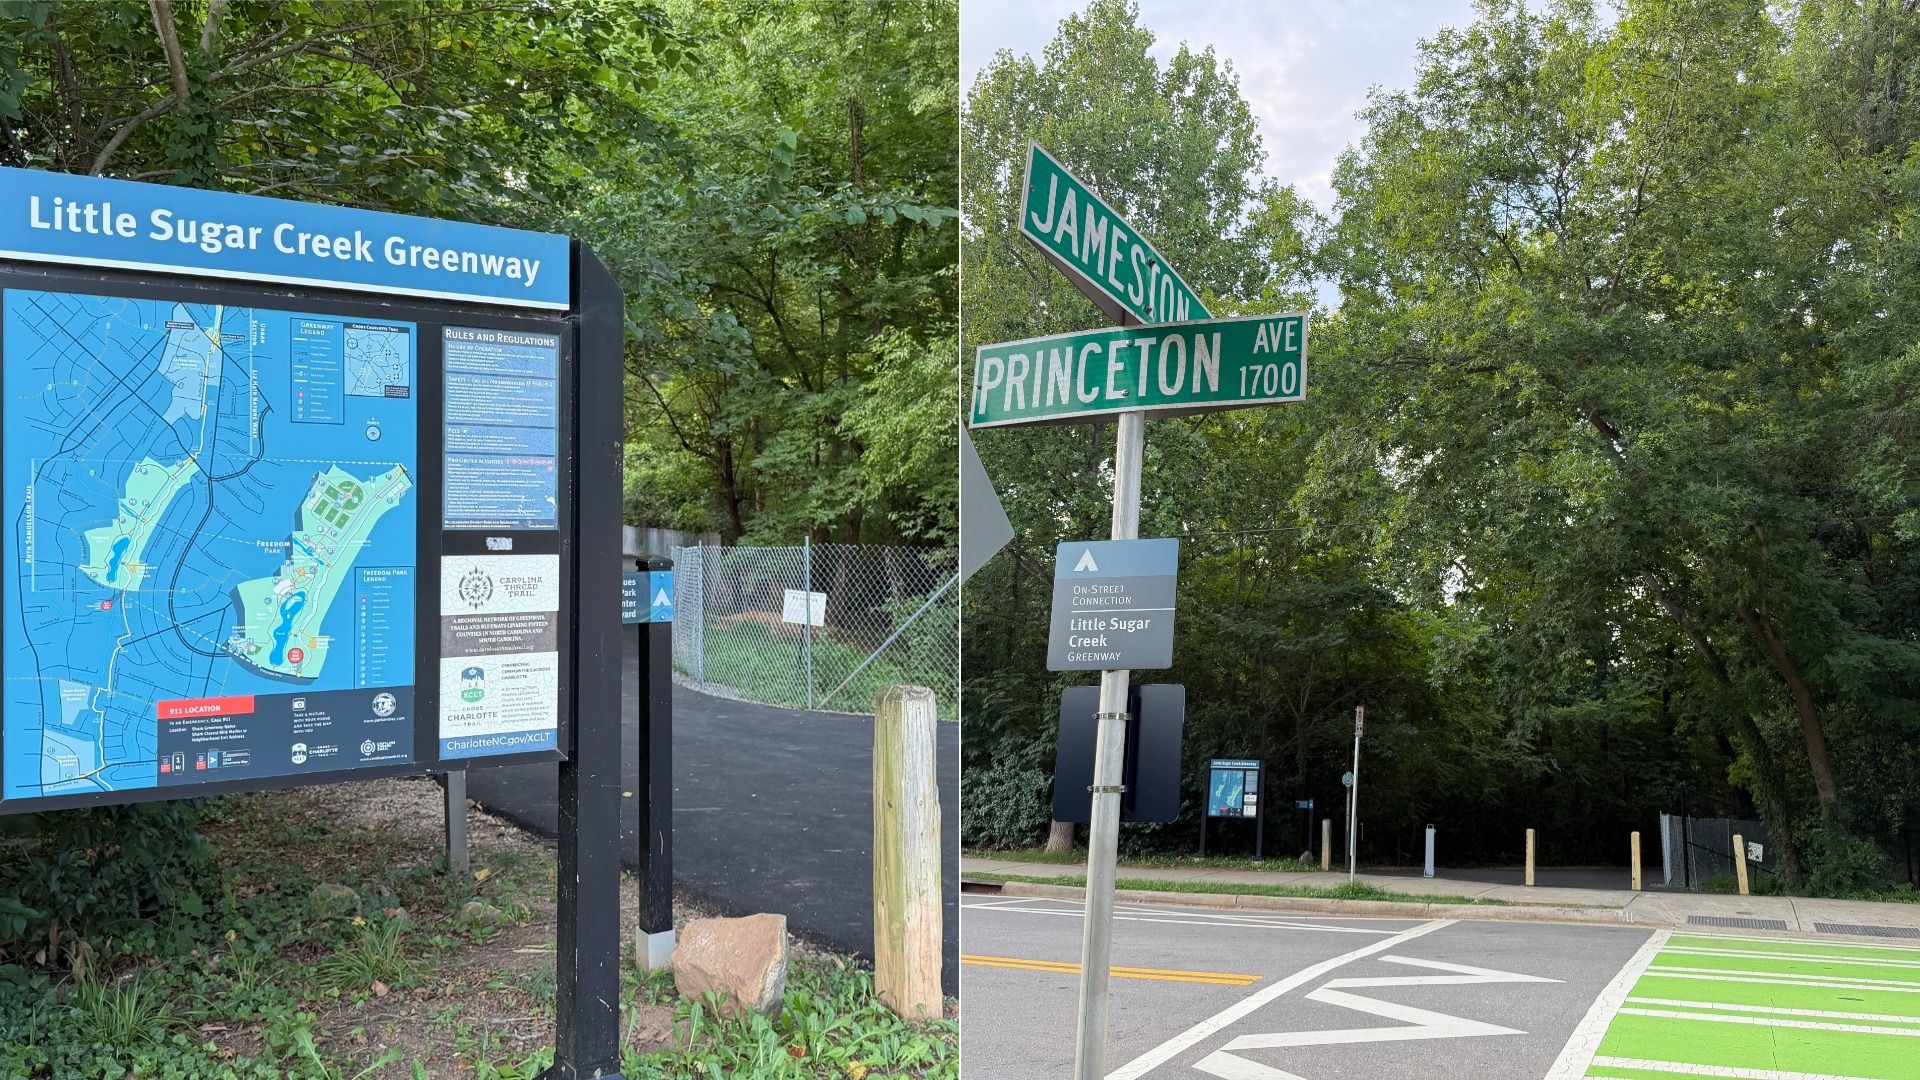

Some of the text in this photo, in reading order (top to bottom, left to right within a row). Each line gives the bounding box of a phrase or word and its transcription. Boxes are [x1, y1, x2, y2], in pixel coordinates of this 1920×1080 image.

[30, 195, 540, 288] Little Sugar Creek Greenway
[1031, 172, 1190, 324] JAMESTON
[300, 322, 334, 330] GREENWAY
[446, 328, 555, 347] RULES AND REGULATIONS
[978, 320, 1298, 415] PRINCETON AVE
[1239, 362, 1297, 397] 1700
[1073, 584, 1124, 594] ON-STREET
[1072, 596, 1132, 606] CONNECTION
[1070, 618, 1151, 632] Little Sugar
[1069, 634, 1108, 648] Creek
[1068, 652, 1121, 662] GREENWAY
[185, 705, 221, 714] LOCATION
[448, 712, 497, 722] CHARLOTTE
[446, 732, 550, 750] CharlotteNC.gov/XCLT
